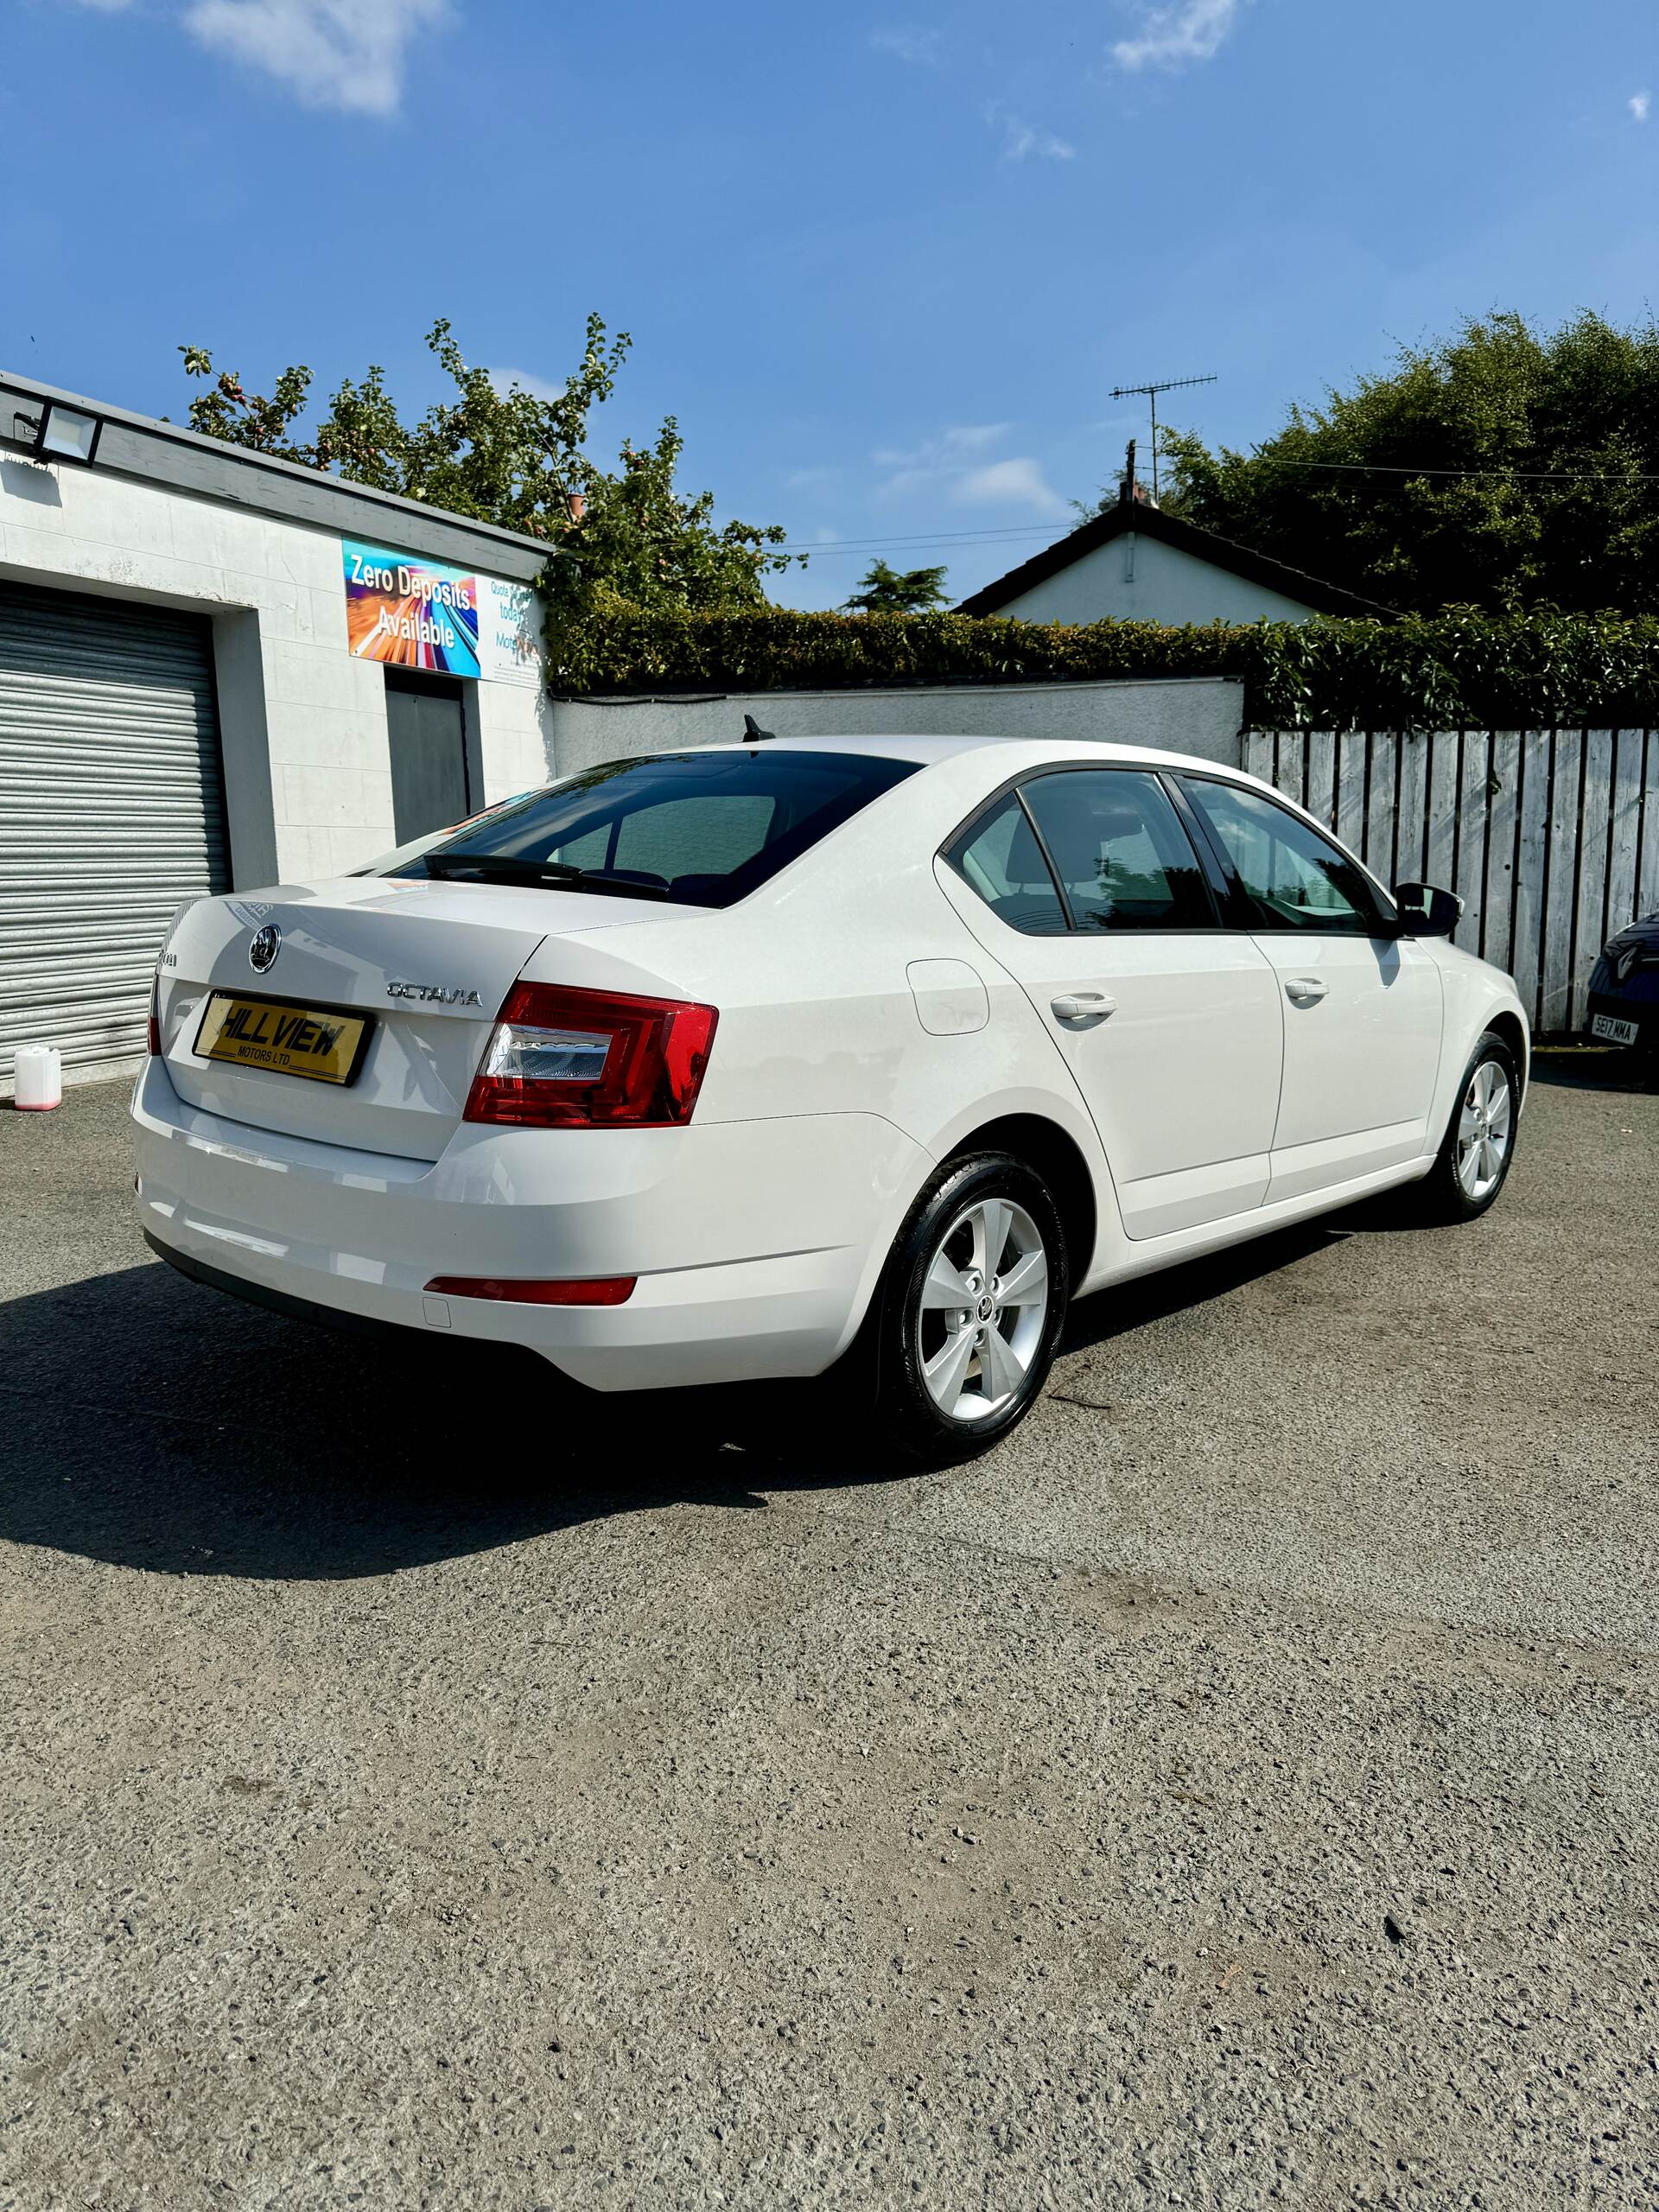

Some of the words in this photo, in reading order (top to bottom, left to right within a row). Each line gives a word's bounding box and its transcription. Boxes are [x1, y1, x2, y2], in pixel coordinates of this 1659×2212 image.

[351, 554, 393, 592] Zero
[398, 566, 470, 611] Deposits
[491, 581, 509, 597] Quote
[378, 606, 454, 648] Available
[387, 982, 483, 1007] OCTAVIA
[237, 1046, 271, 1062] MOTORS
[273, 1052, 290, 1065] LTD
